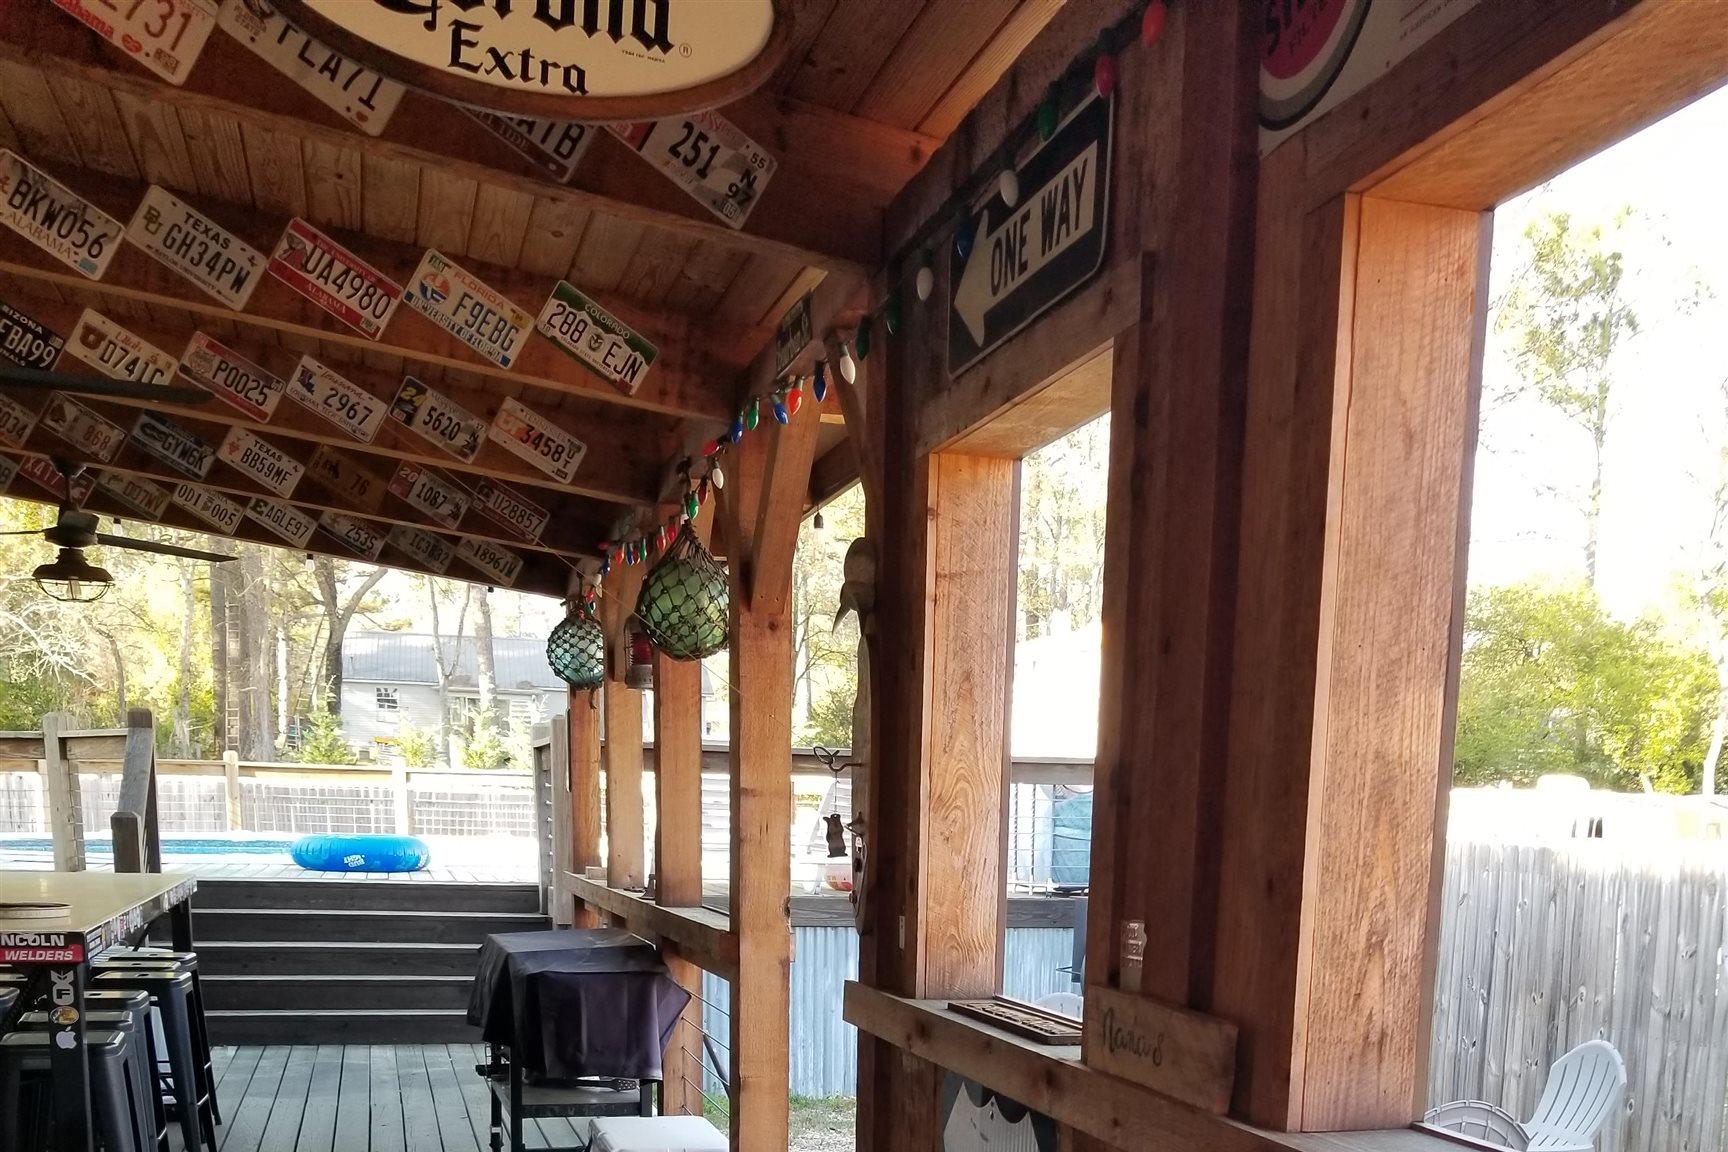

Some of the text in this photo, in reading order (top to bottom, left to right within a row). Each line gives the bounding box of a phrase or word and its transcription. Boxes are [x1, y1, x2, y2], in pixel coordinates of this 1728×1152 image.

[374, 0, 676, 56] ona
[447, 18, 589, 96] Extra
[667, 121, 720, 179] 251
[184, 211, 232, 249] TEXAS
[989, 158, 1088, 298] ONE WAY
[162, 223, 251, 294] GH34PW
[304, 244, 392, 319] UA4980
[454, 271, 504, 310] FLORIDA
[585, 304, 630, 339] COLORADO
[546, 302, 644, 384] 288 EJN
[323, 387, 373, 426] 2967
[422, 405, 462, 442] 5620
[253, 439, 283, 463] TEXAS
[519, 423, 566, 463] 3458
[240, 447, 293, 486] BB59MF
[399, 466, 419, 483] 20
[416, 482, 449, 510] 1087
[493, 483, 544, 533] U28857
[5, 950, 74, 961] WELDERS
